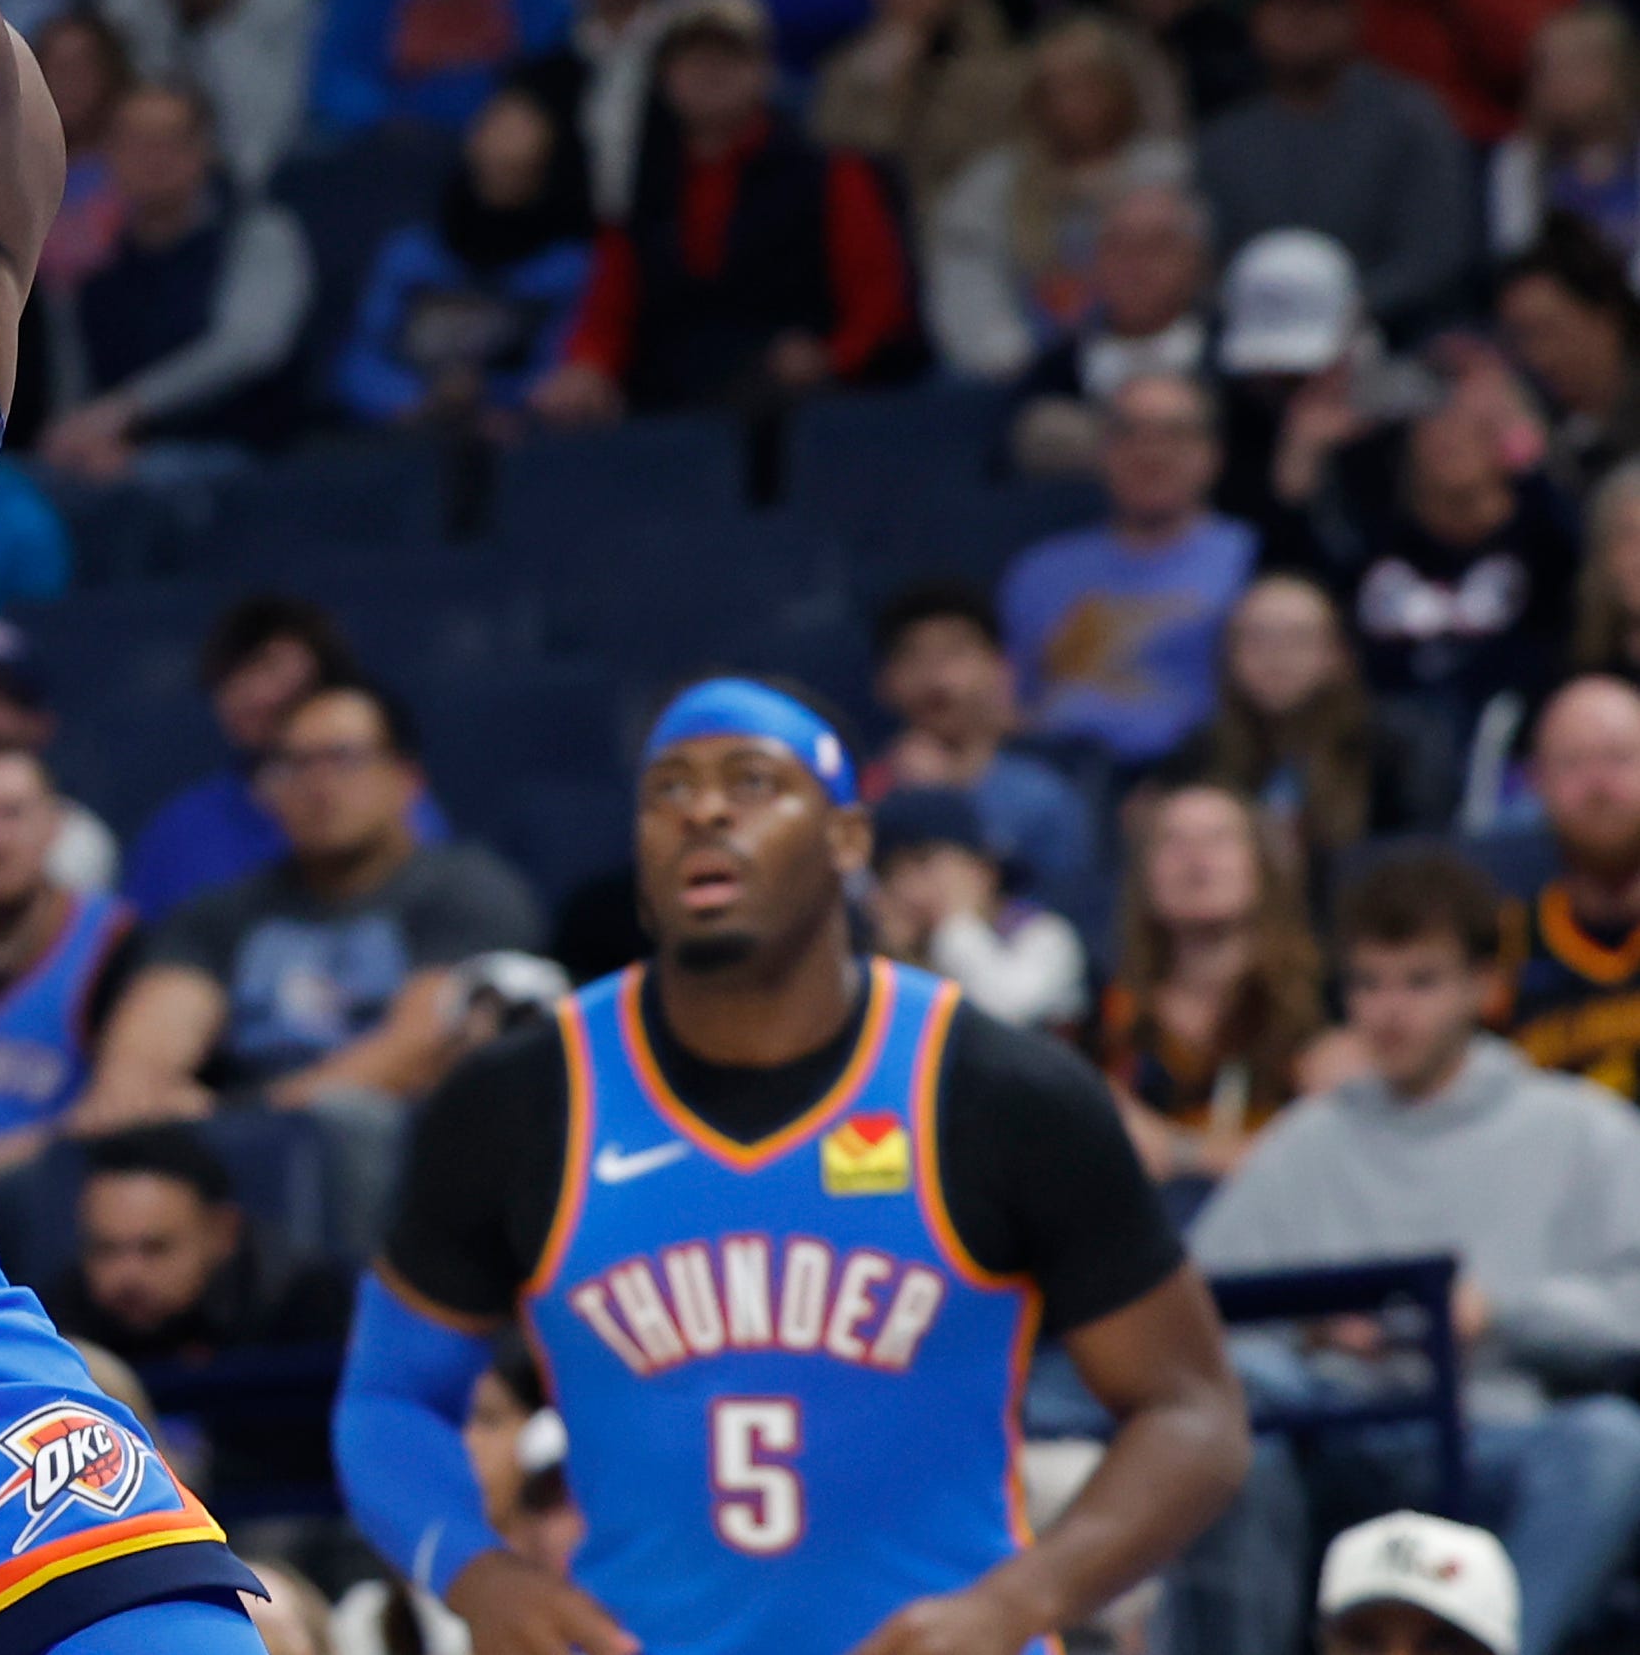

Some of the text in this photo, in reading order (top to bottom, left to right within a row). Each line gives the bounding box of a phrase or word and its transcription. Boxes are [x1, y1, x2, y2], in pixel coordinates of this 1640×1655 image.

[569, 1233, 945, 1376] THUNDER
[31, 1424, 114, 1511] OKC
[711, 1398, 803, 1556] 5
